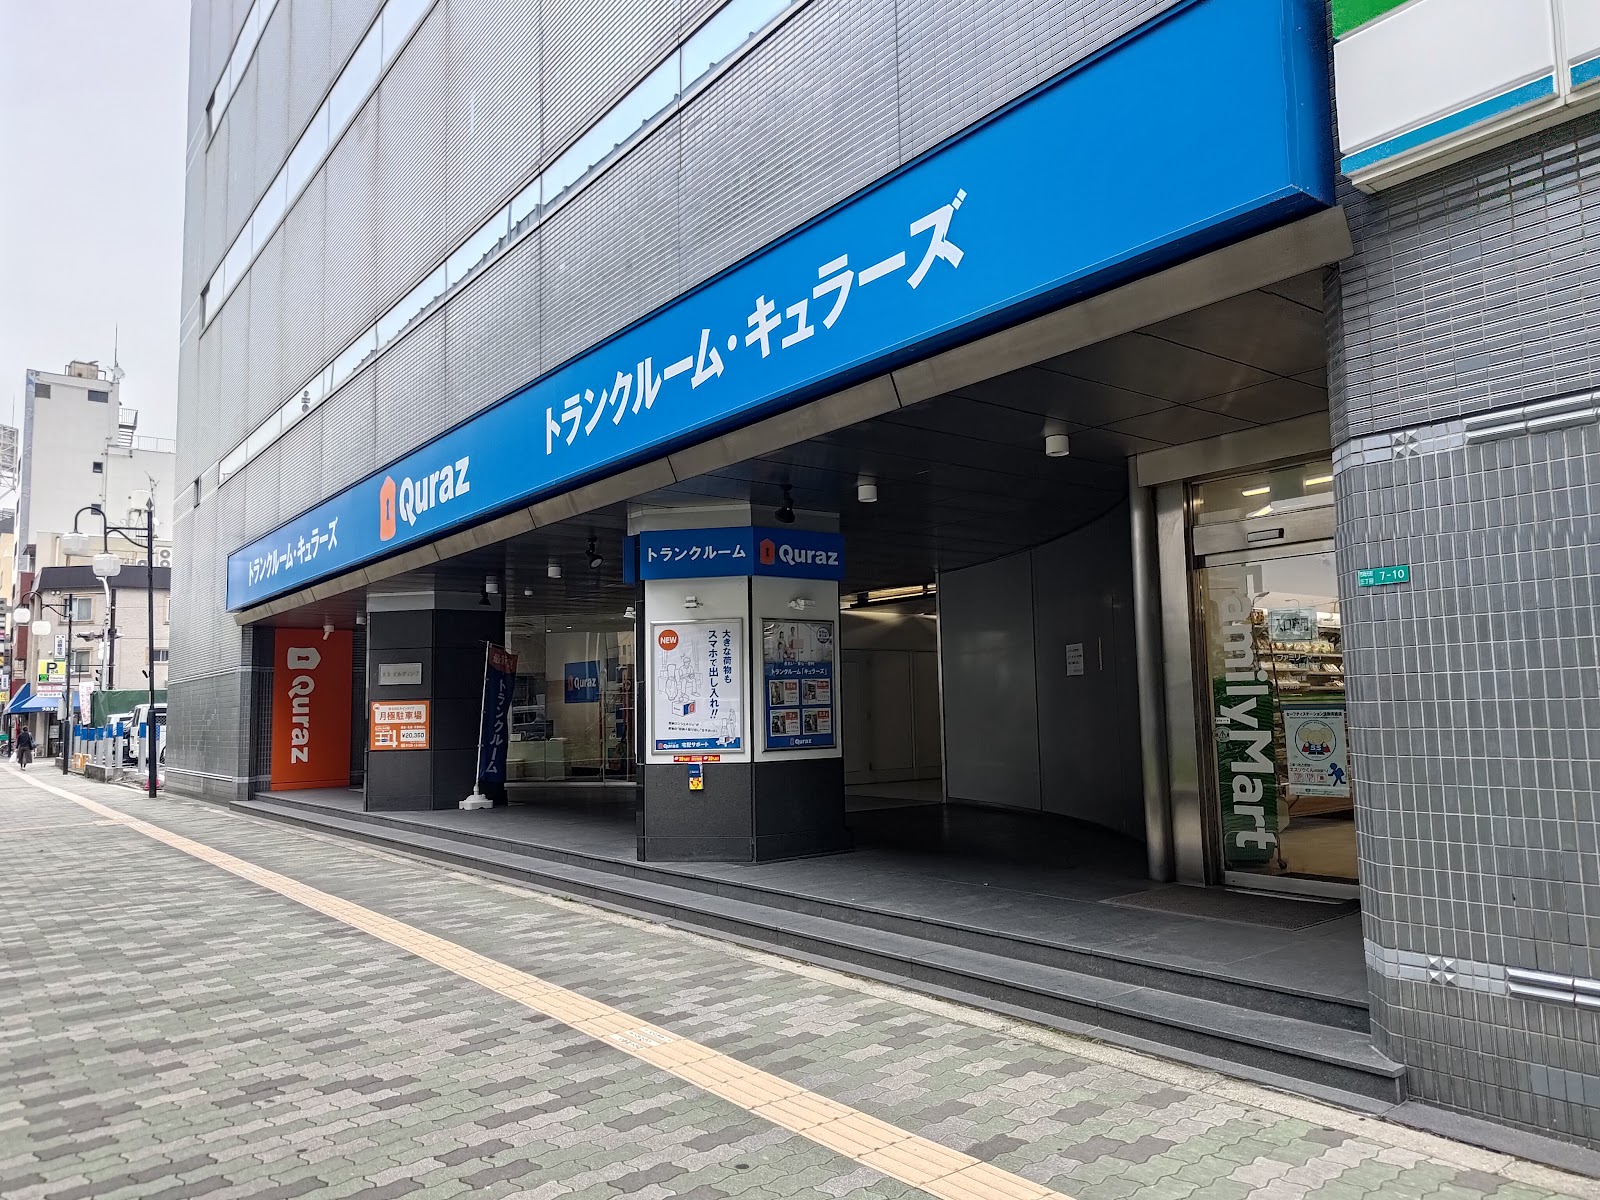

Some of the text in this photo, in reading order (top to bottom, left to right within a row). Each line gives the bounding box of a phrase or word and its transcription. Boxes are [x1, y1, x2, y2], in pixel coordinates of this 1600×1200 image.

[546, 188, 967, 456] トランクルーム・キュラーズ
[399, 455, 470, 527] Quraz
[248, 516, 339, 587] トランクルーム・キュラーズ
[647, 544, 746, 563] トランクルーム
[779, 544, 839, 566] Quraz
[1379, 569, 1405, 581] 7-10
[660, 637, 678, 645] NEW
[722, 629, 732, 684] 大きな荷物も
[46, 662, 58, 674] P
[574, 677, 597, 690] Quraz
[287, 675, 315, 764] Quraz
[379, 710, 422, 721] 月極駐車場
[485, 679, 506, 774] トランクルーム
